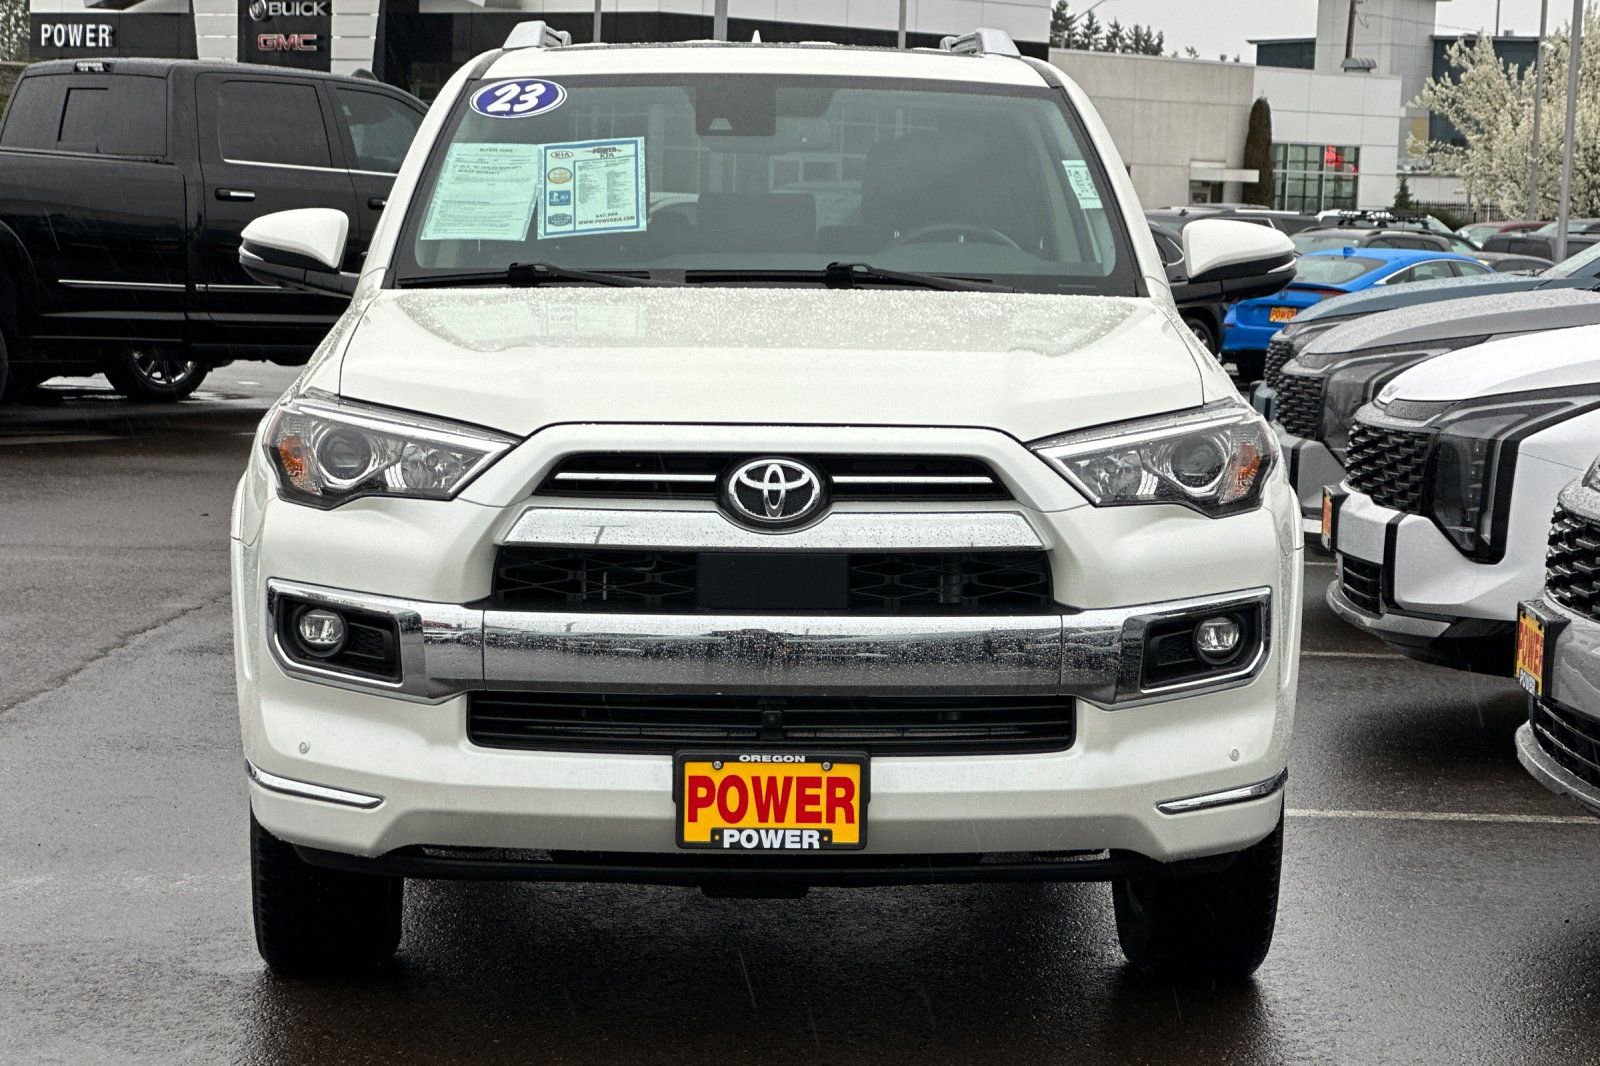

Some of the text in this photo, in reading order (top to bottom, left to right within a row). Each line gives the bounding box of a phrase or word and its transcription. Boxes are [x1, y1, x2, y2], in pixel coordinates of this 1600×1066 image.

[268, 1, 327, 16] BUICK
[41, 23, 113, 47] POWER
[257, 33, 317, 51] GMC
[486, 83, 546, 112] 23
[738, 754, 806, 763] OREGON
[687, 774, 855, 825] POWER
[723, 829, 820, 849] POWER
